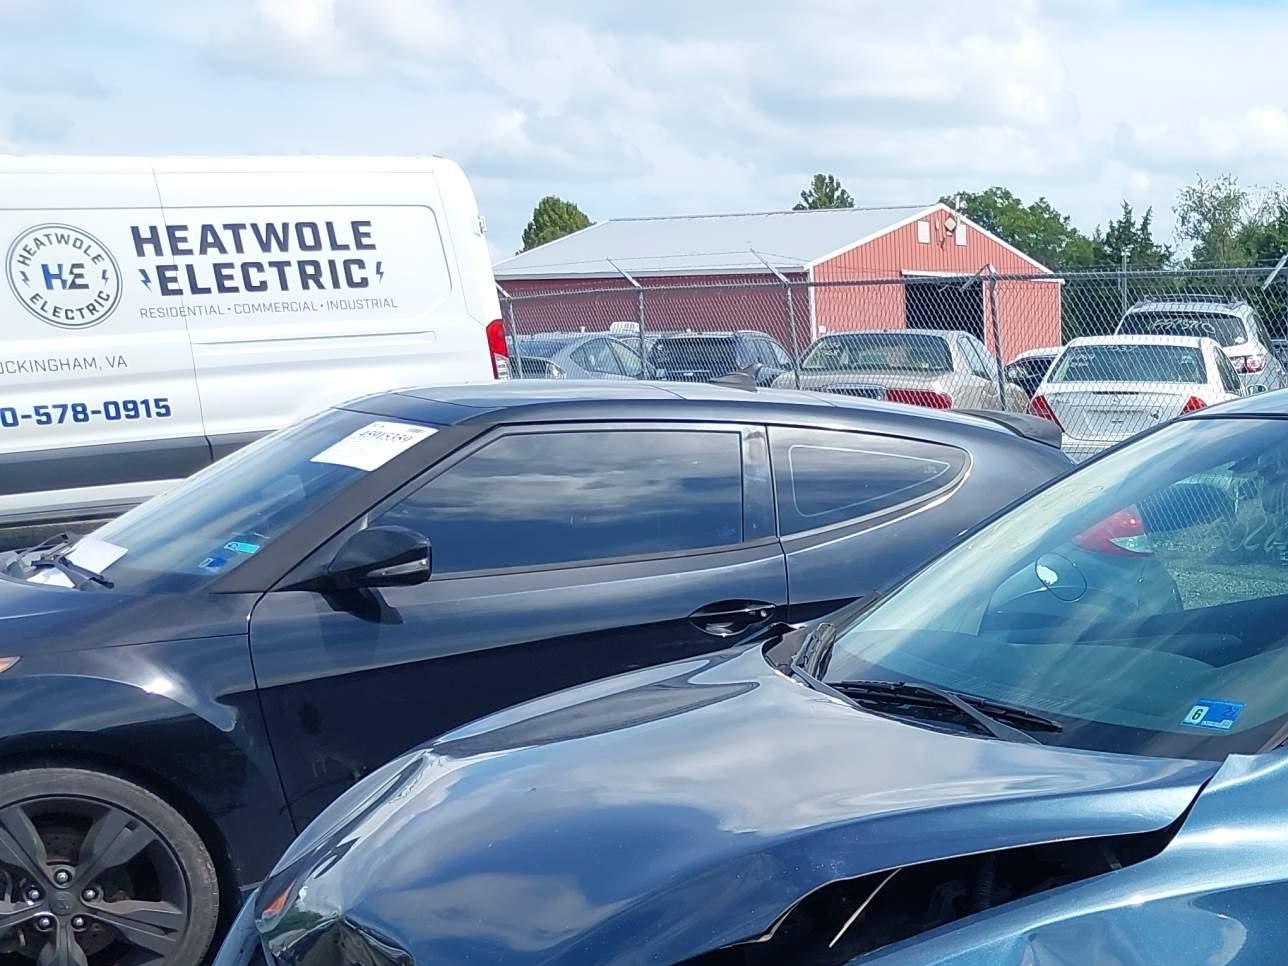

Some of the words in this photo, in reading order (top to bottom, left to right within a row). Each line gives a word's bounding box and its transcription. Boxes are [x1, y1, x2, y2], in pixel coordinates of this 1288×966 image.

[17, 232, 105, 267] HEATWOLE
[130, 220, 376, 257] HEATWOLE
[41, 262, 90, 290] HE
[156, 258, 369, 297] ELECTRIC
[29, 290, 111, 321] ELECTRIC
[139, 304, 224, 319] RESIDENTIAL
[233, 300, 319, 315] COMMERCIAL
[326, 297, 399, 312] INDUSTRIAL
[105, 355, 128, 369] VA
[1191, 708, 1204, 720] 6
